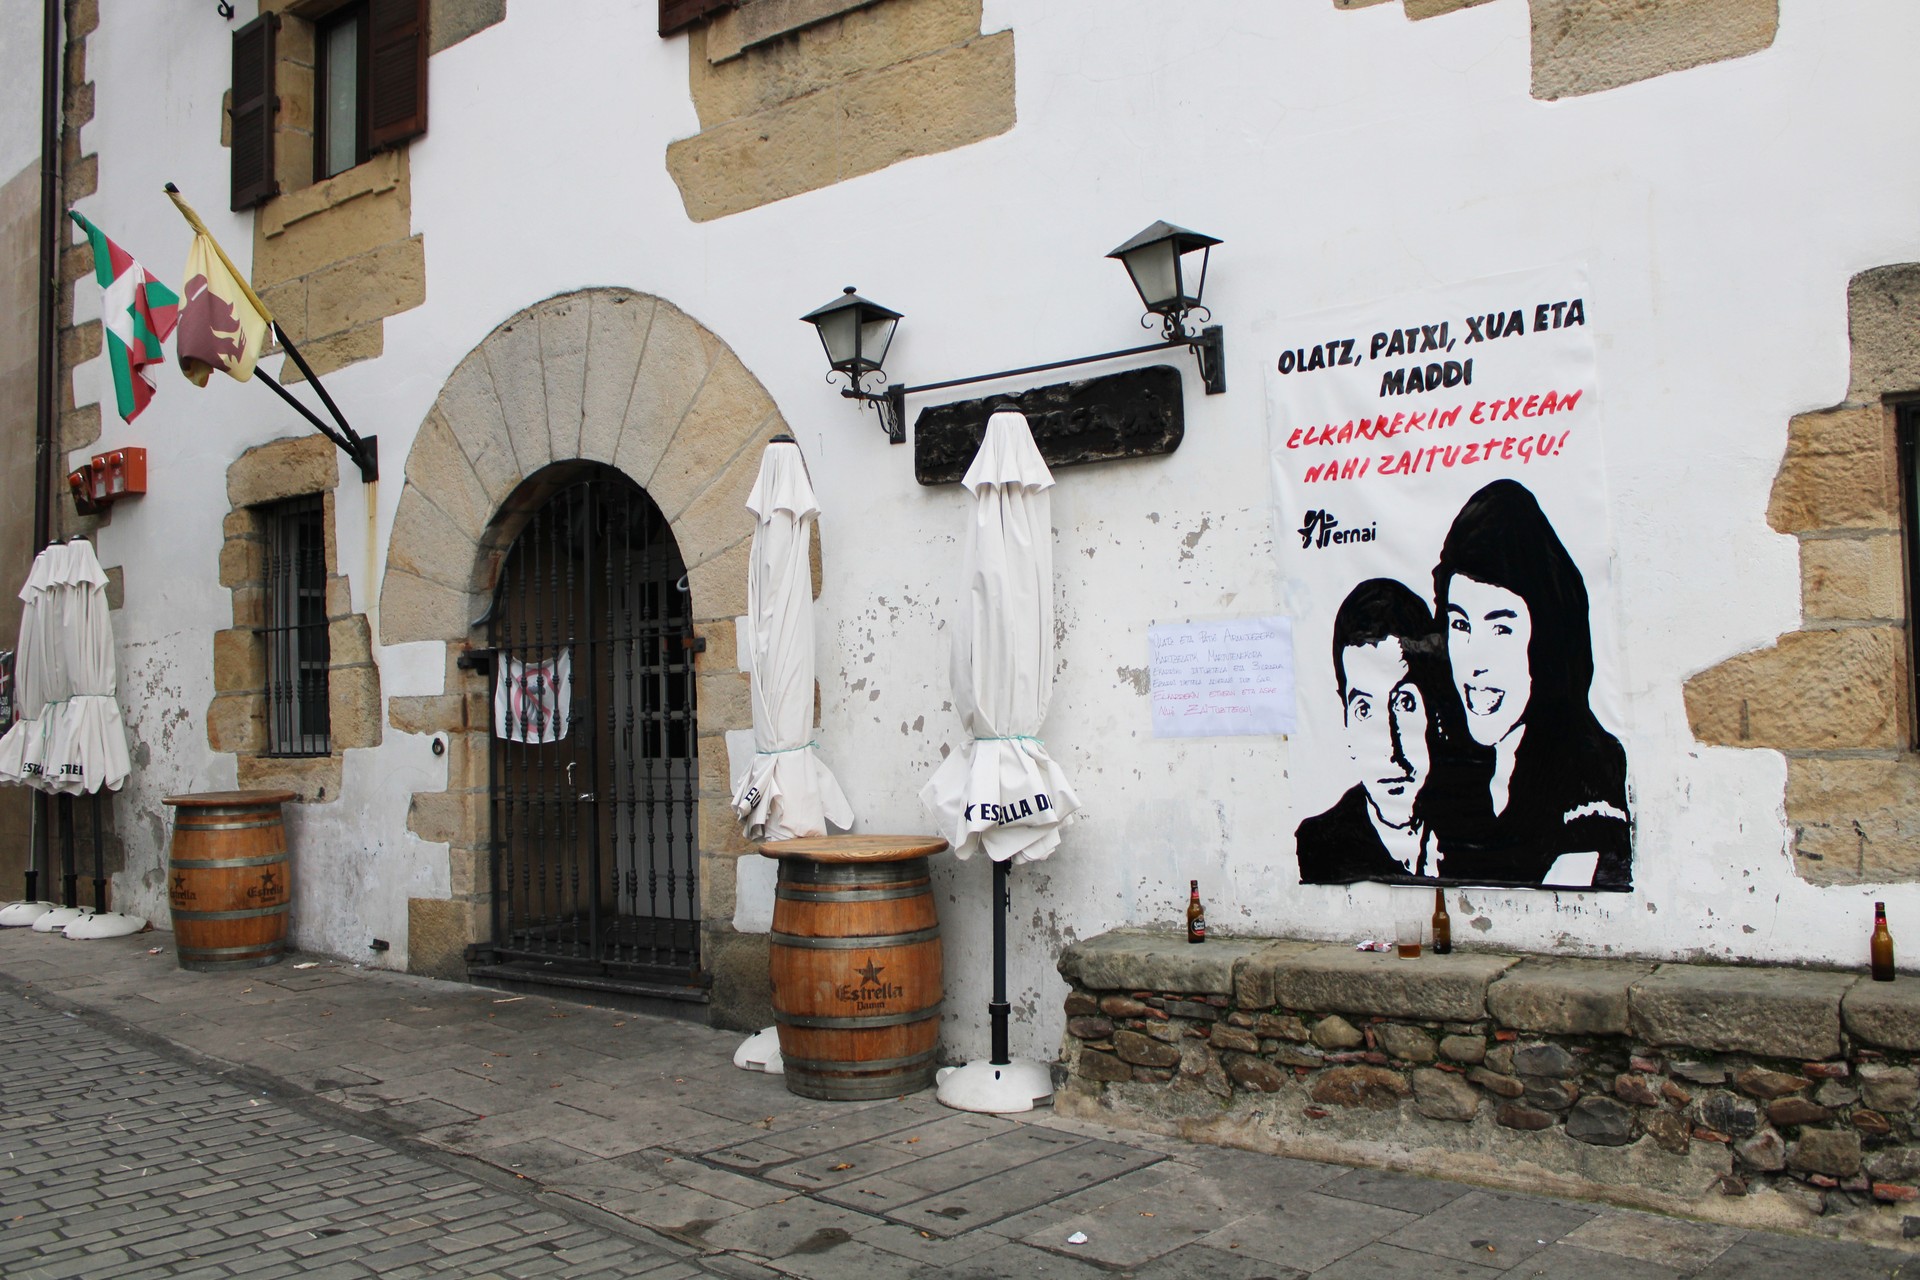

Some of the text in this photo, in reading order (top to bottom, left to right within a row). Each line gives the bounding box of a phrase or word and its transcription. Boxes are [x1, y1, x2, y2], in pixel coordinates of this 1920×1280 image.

[1277, 298, 1586, 375] OLATZ, PATXI, XUA ETA
[1379, 358, 1474, 397] MADDI
[1286, 388, 1584, 449] ELKARREKIN ETXEAN
[1303, 430, 1571, 483] NAHI ZAITUZTEGU!
[836, 982, 904, 1002] Estrella
